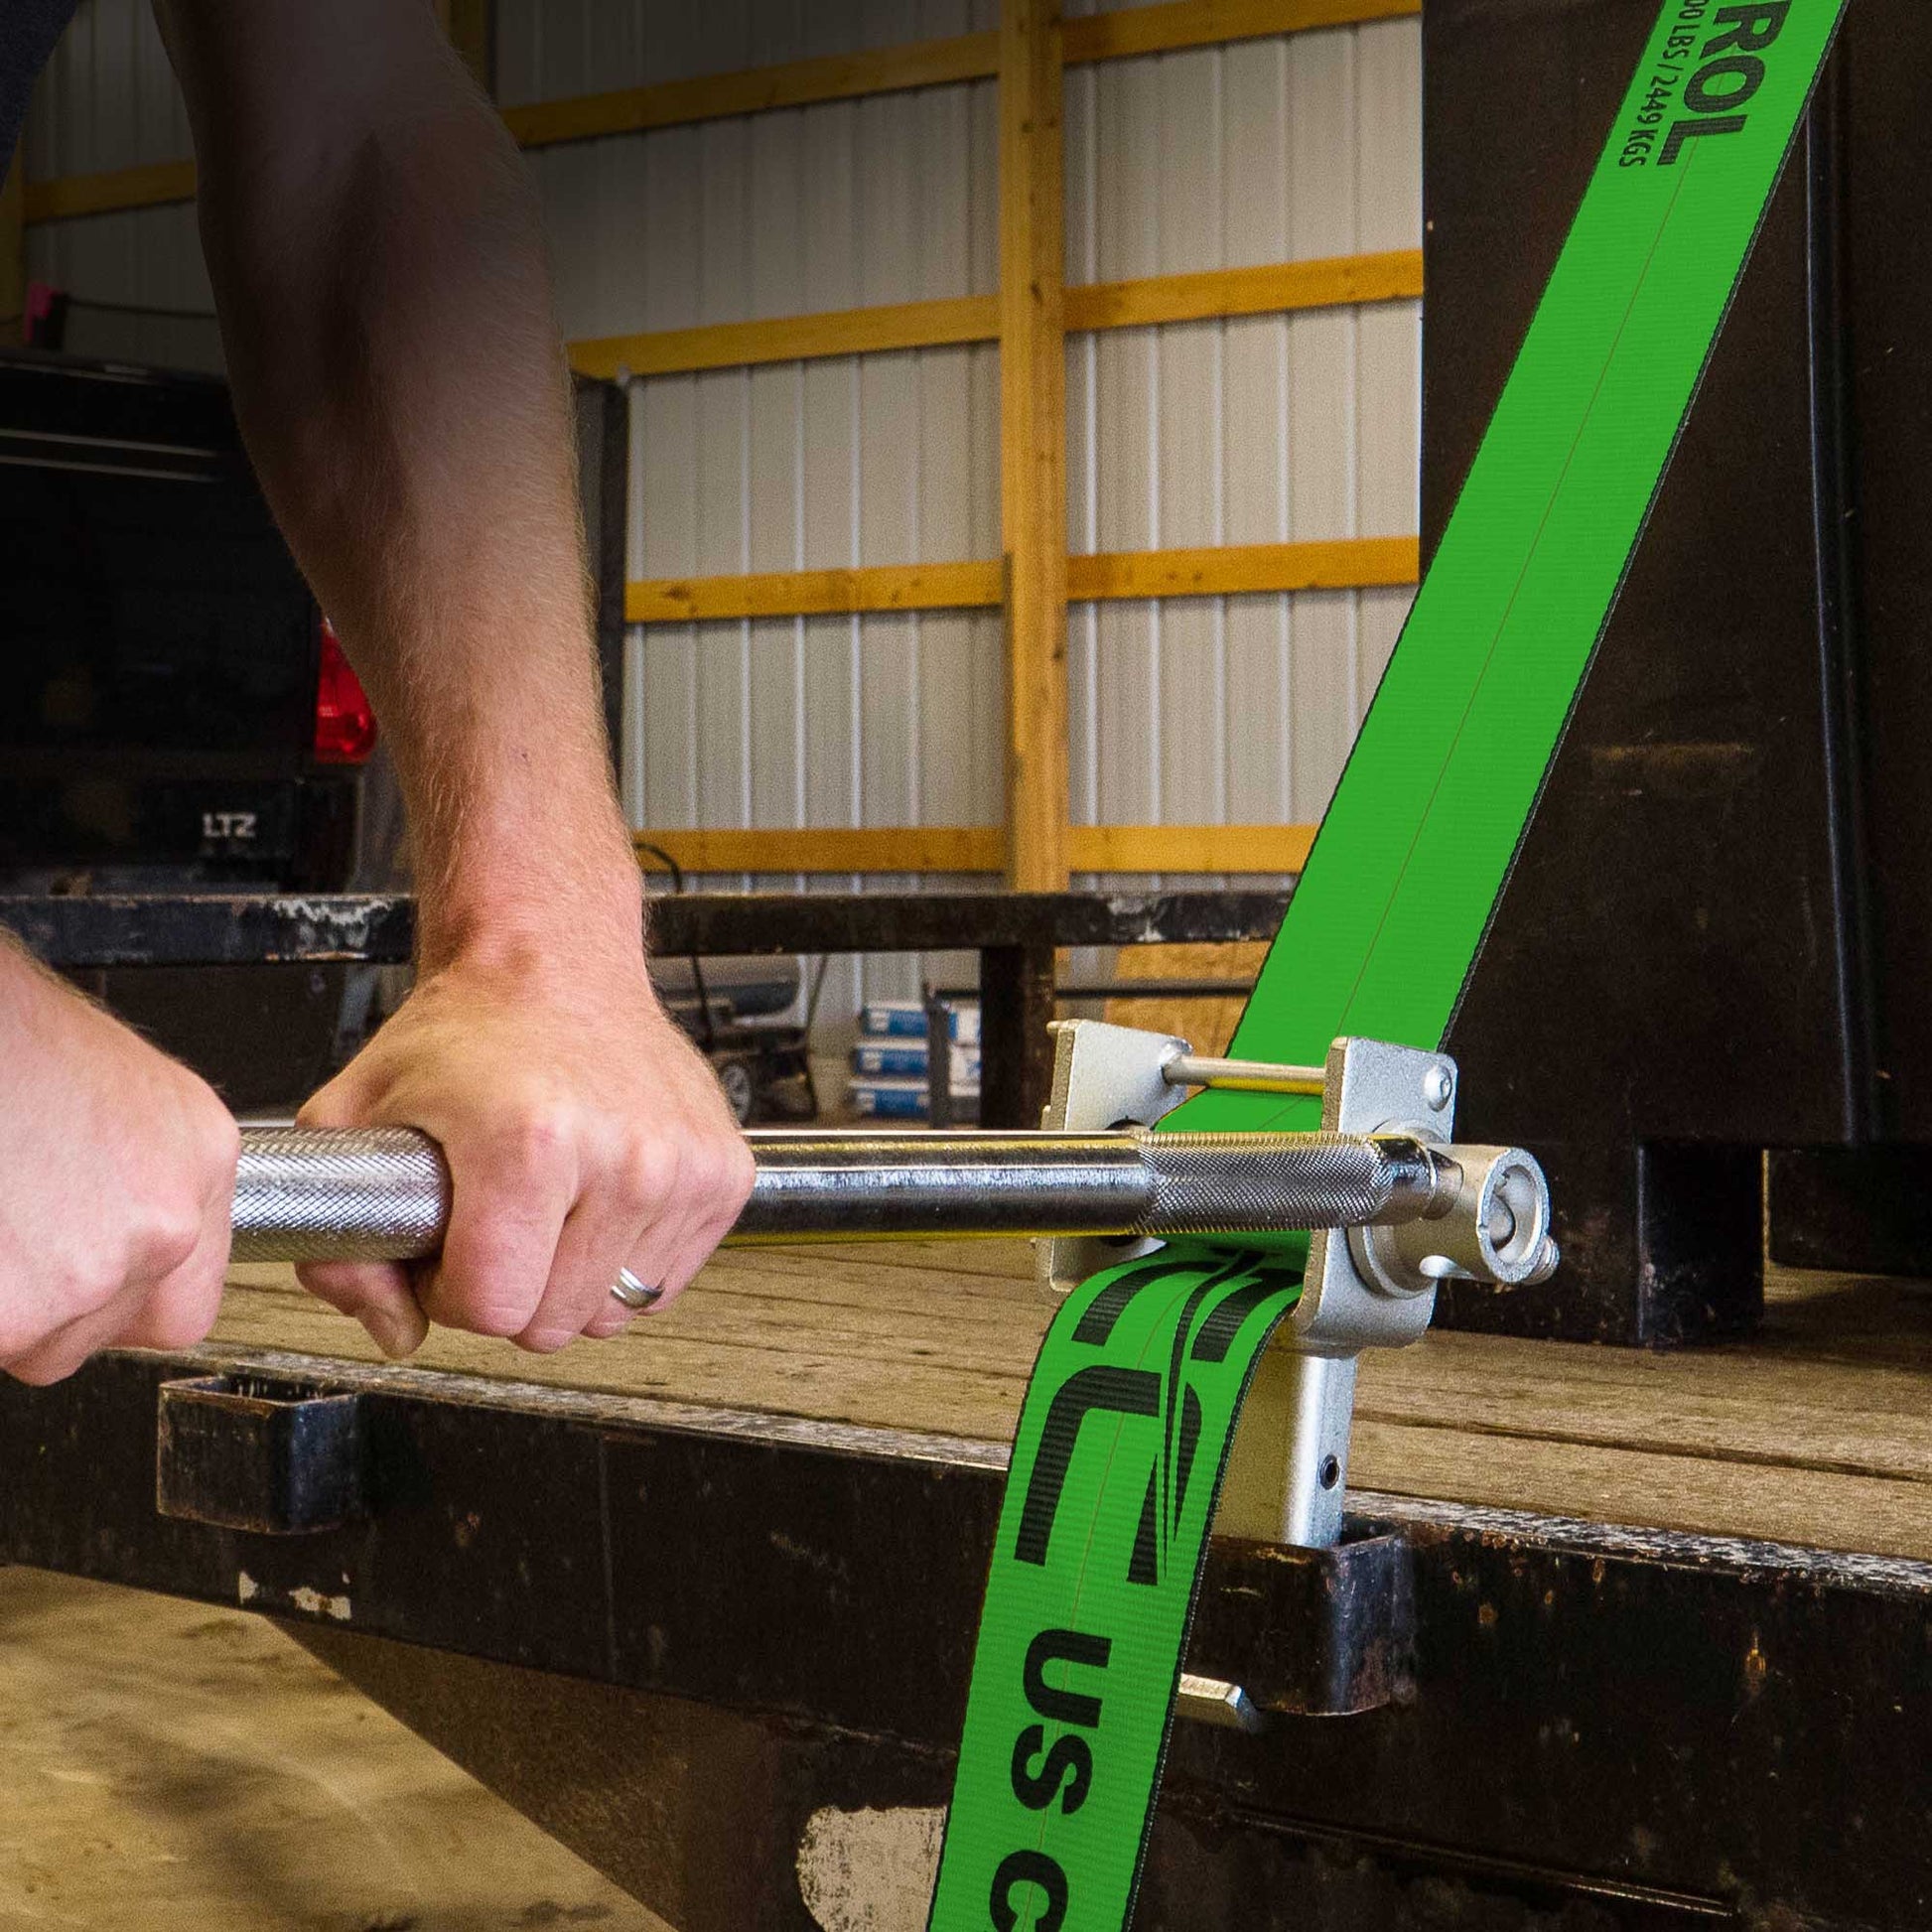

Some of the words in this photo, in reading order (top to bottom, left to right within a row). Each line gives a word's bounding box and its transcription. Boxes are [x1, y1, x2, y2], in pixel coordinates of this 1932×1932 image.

[1662, 24, 1700, 60] LBS
[1637, 74, 1679, 125] 2449
[1657, 0, 1790, 166] ROL
[1618, 129, 1659, 168] KGS
[203, 812, 256, 837] LTZ
[1011, 1628, 1112, 1816] US
